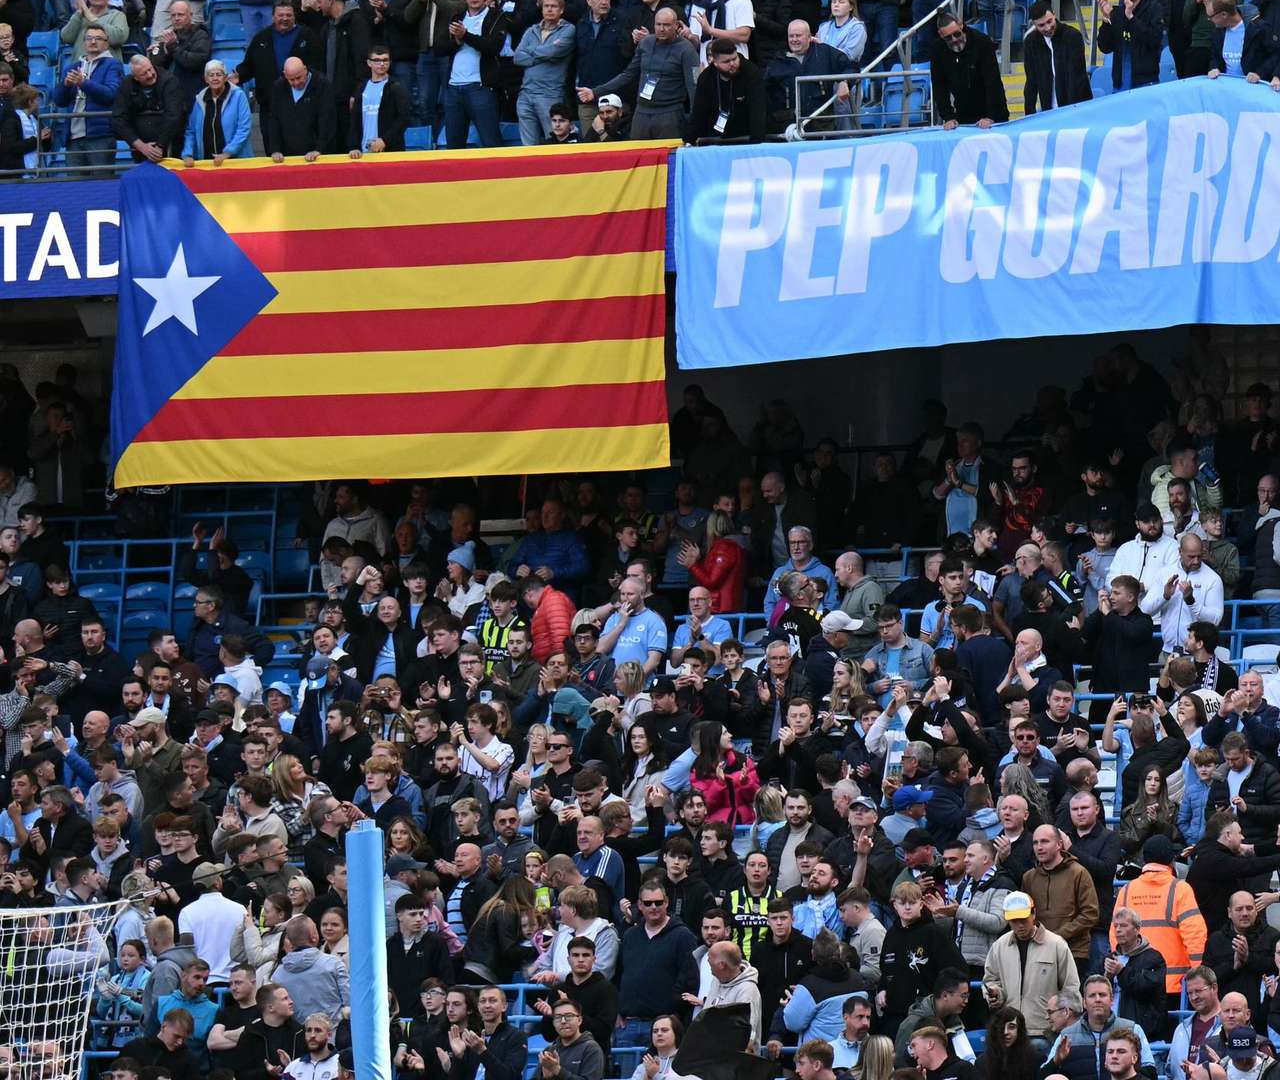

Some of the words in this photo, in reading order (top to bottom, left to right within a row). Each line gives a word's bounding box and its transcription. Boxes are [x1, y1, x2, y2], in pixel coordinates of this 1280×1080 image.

[0, 209, 120, 281] TAD
[714, 142, 918, 308] PEP
[734, 914, 769, 922] ETIHA
